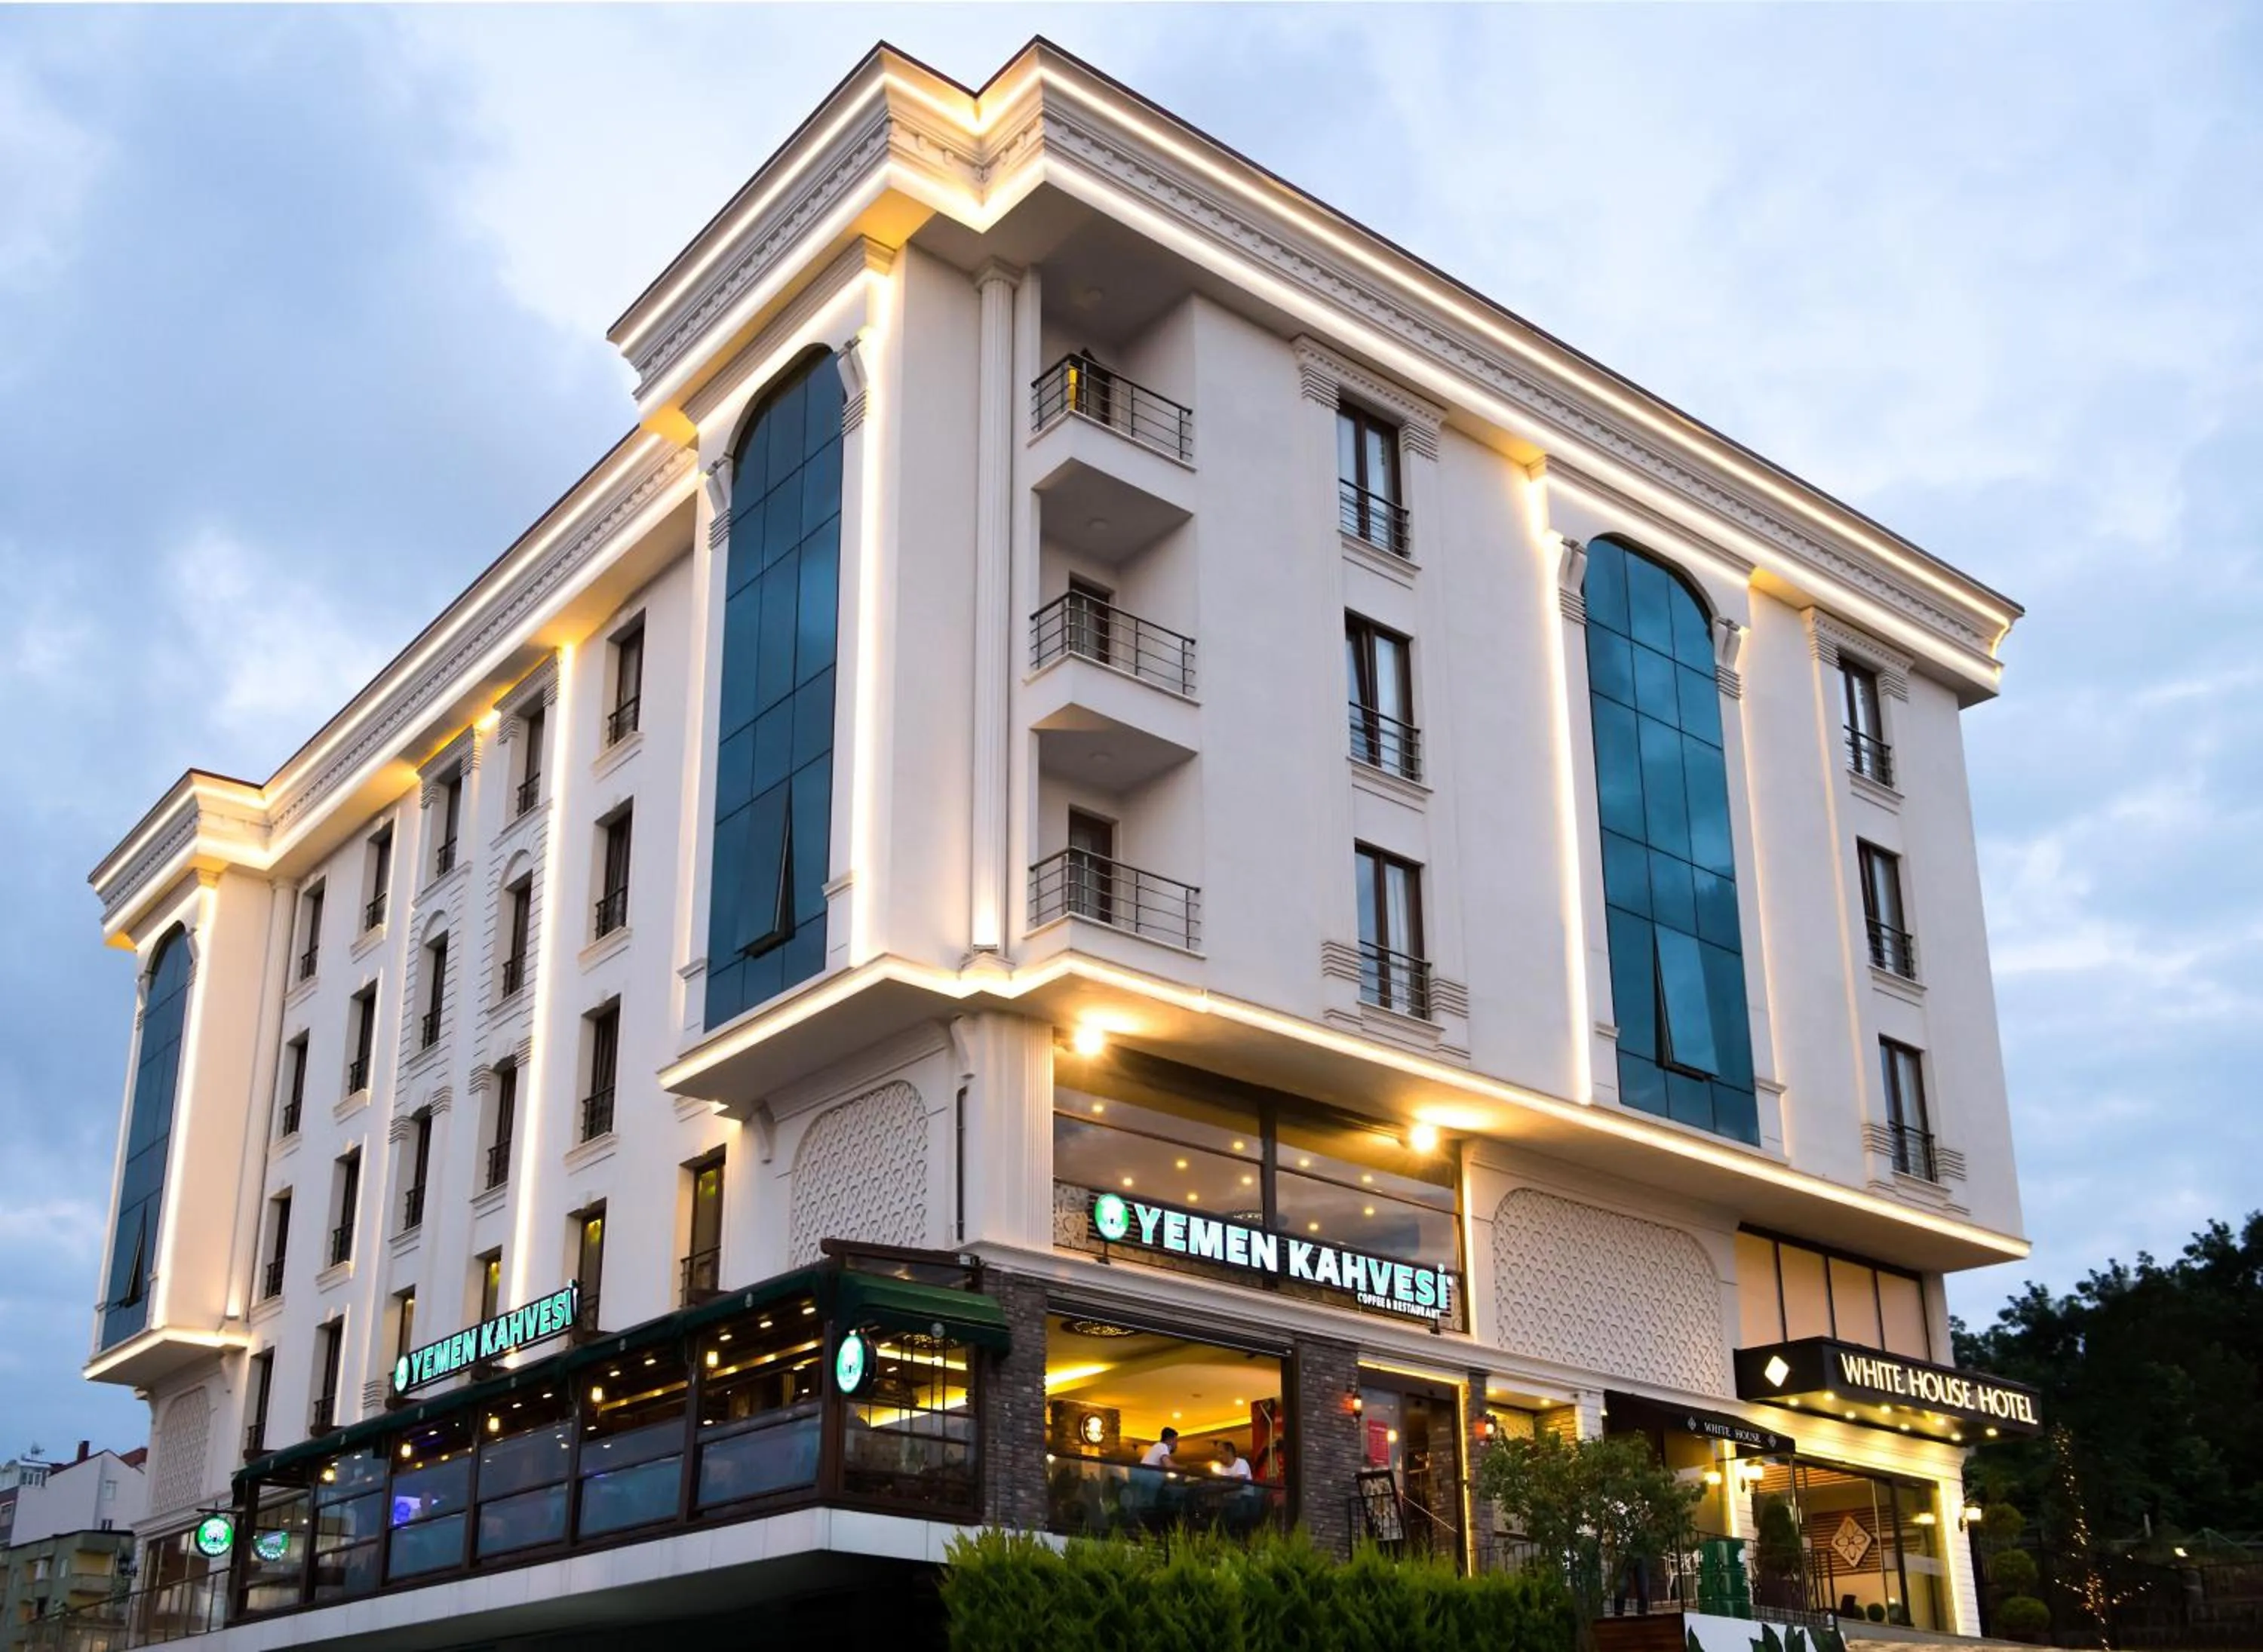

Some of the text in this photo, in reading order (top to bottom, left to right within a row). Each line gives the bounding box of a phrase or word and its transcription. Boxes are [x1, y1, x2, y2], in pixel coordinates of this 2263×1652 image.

[1134, 1202, 1279, 1273] YEMEN
[1357, 1292, 1440, 1319] COFFEE & RESTAURANT
[410, 1328, 477, 1384] YEMEN
[1840, 1353, 2037, 1425] WHITE HOUSE HOTEL
[1704, 1421, 1761, 1443] WHITE HOUSE
